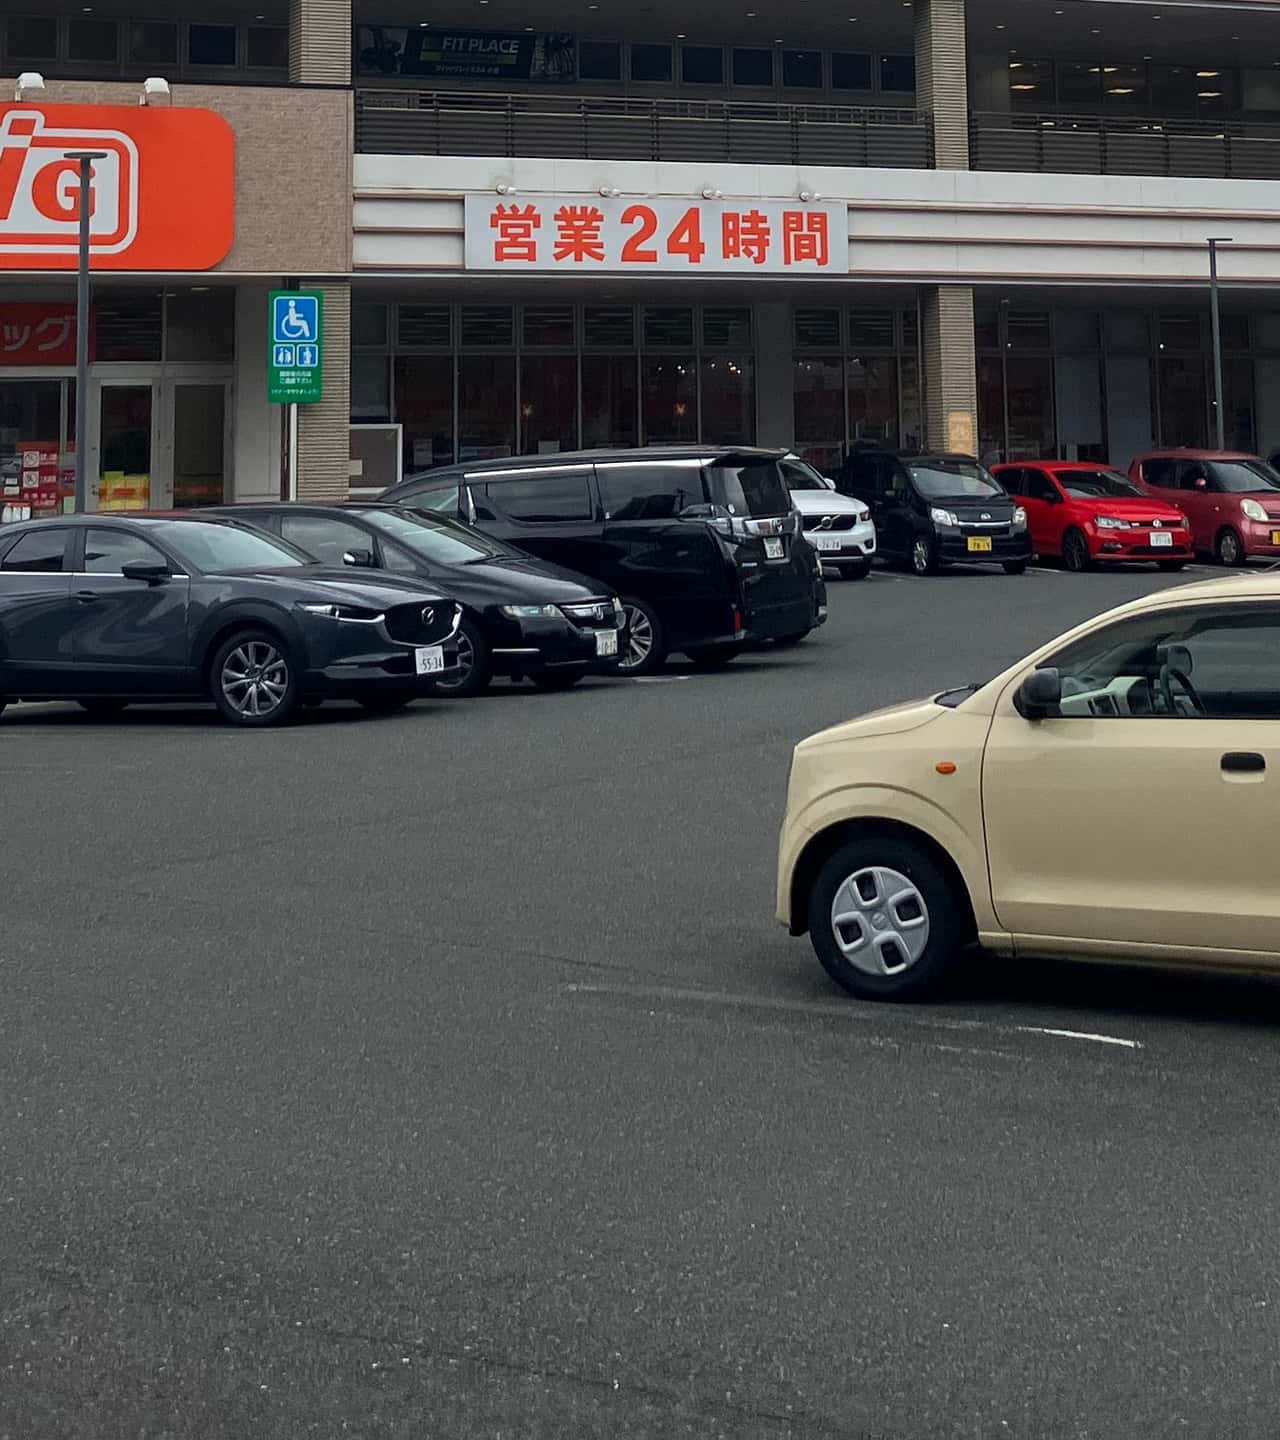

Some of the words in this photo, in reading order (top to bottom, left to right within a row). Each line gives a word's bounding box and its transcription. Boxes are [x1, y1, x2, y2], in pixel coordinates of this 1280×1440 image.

[489, 203, 830, 266] 営業24時間
[422, 656, 442, 671] 55-34
